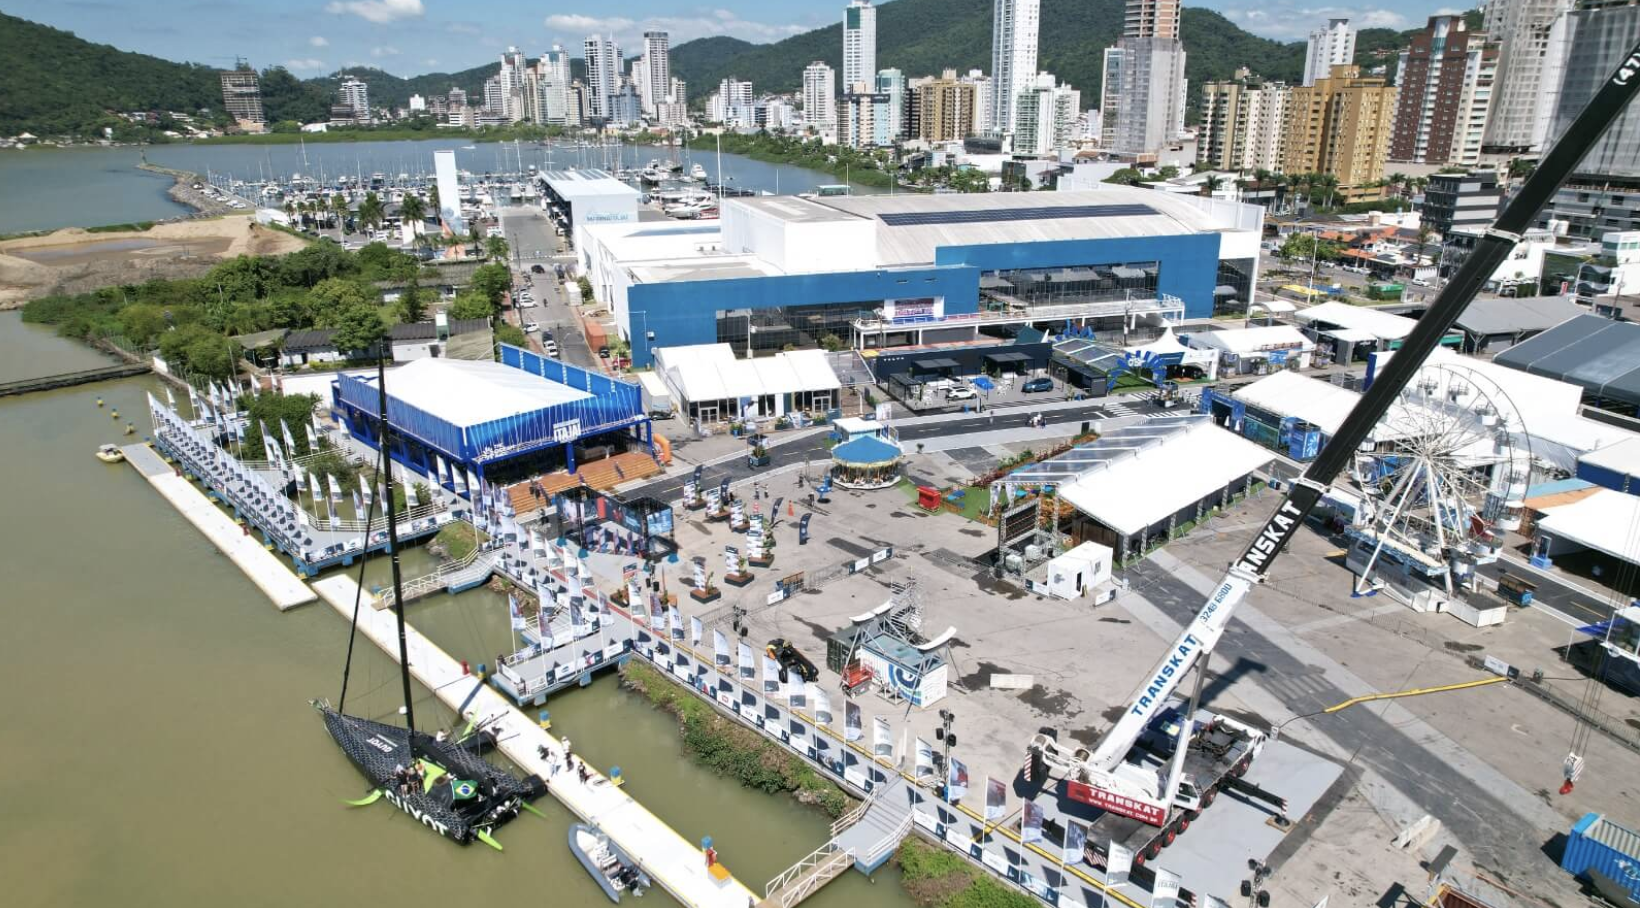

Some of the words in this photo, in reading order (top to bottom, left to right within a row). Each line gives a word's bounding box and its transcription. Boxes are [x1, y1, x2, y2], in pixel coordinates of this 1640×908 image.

[1131, 633, 1197, 716] TRANSKAT
[366, 737, 393, 753] GUYOT
[1089, 788, 1160, 816] TRANSKAT
